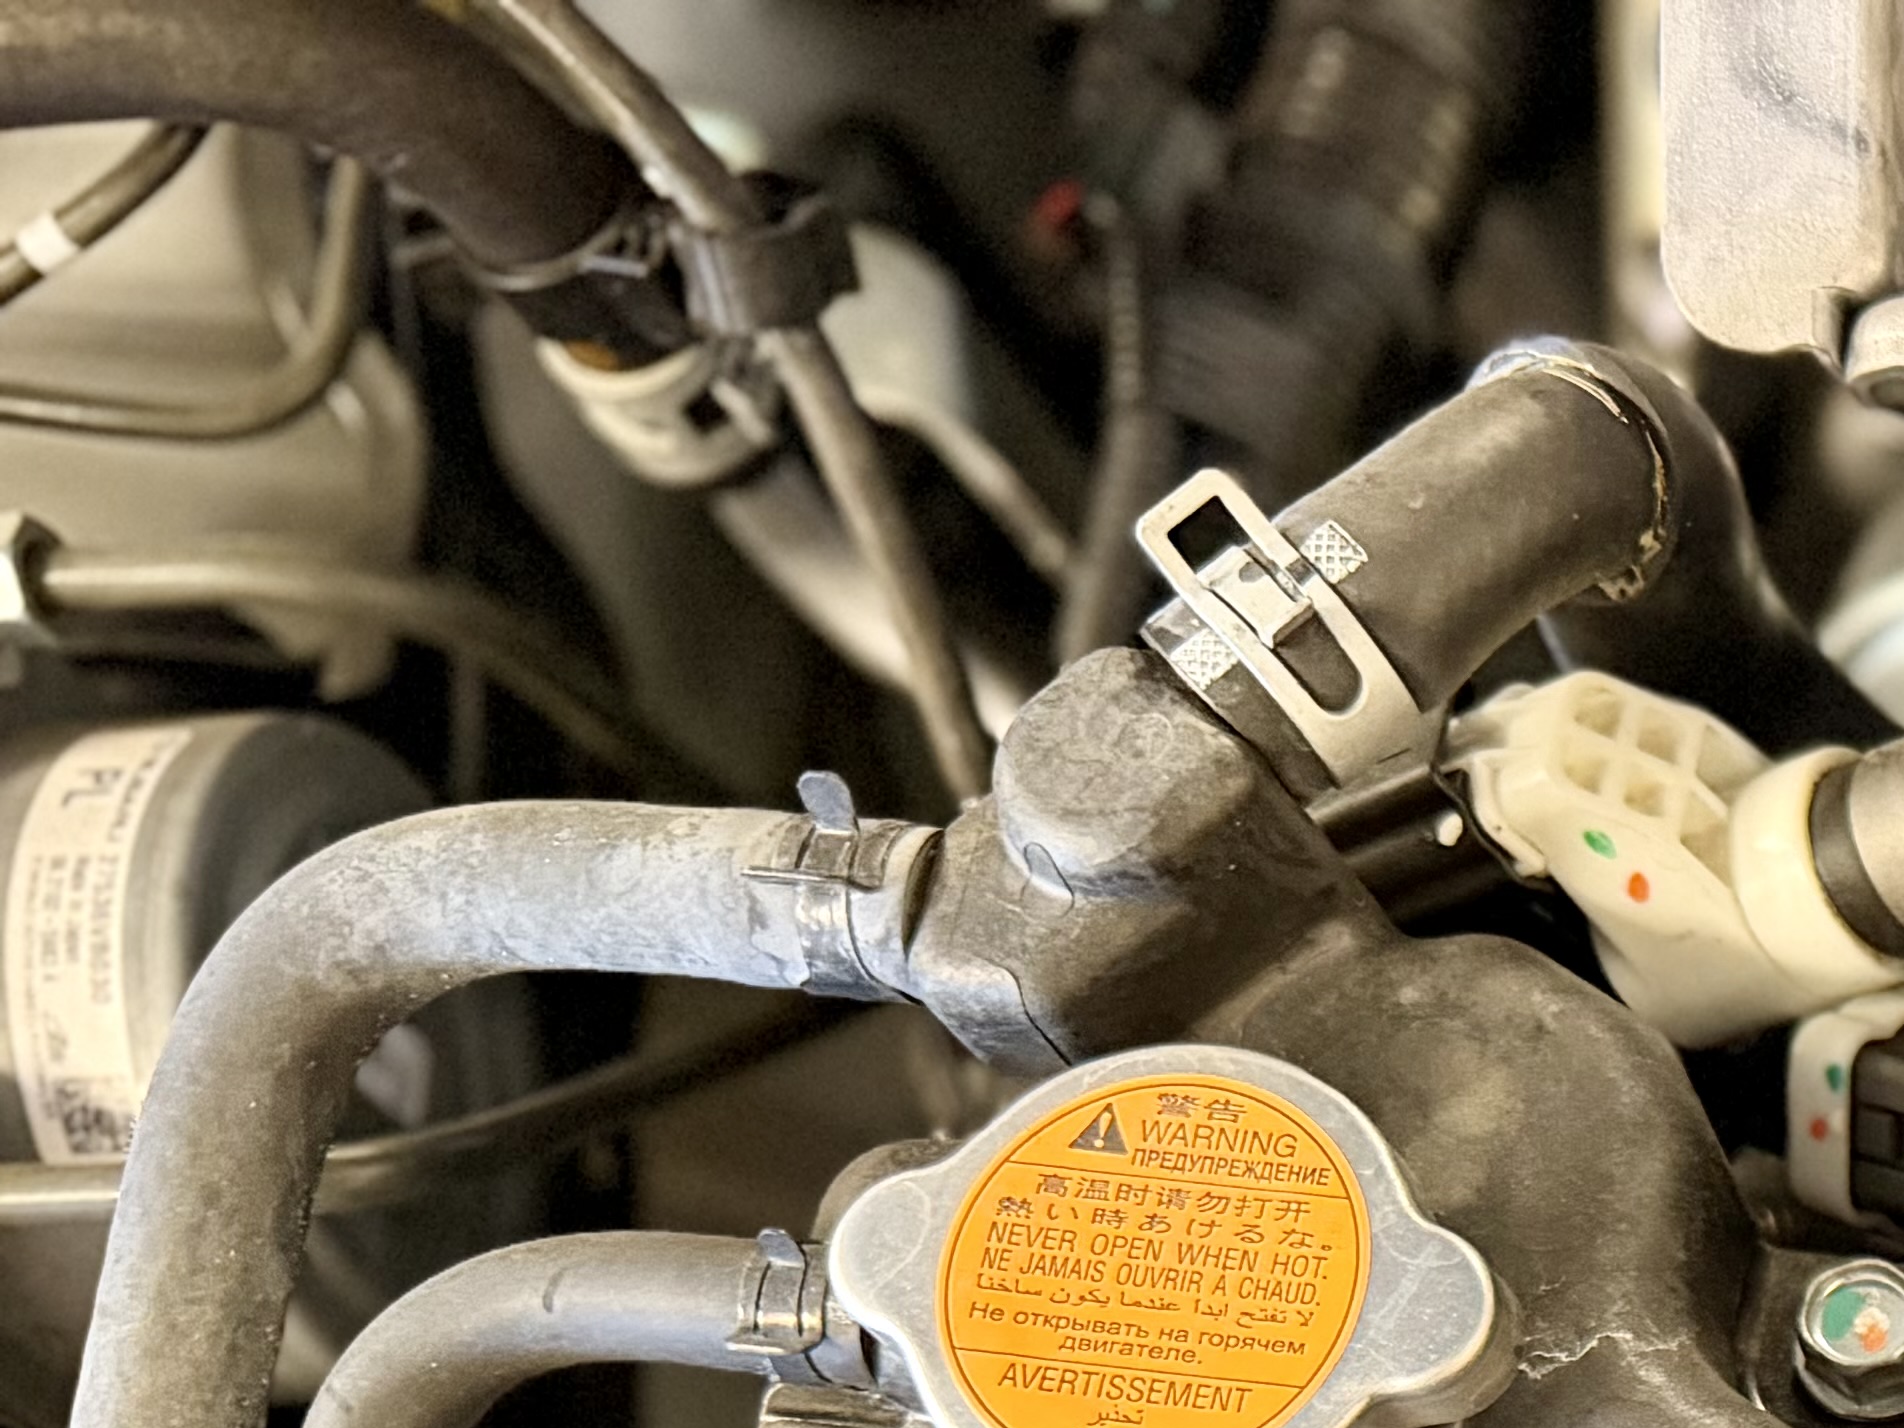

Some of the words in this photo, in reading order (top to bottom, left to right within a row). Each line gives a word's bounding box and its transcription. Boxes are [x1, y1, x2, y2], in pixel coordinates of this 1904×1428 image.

[1157, 1092, 1247, 1124] 警告
[1141, 1119, 1298, 1158] WARNING
[1131, 1147, 1332, 1186] ПРЕДУПРЕЖДЕНИЕ
[995, 1195, 1333, 1252] 熱い時あけるな。
[1035, 1172, 1312, 1224] 高温时请勿打开
[980, 1246, 1014, 1273] NE
[1019, 1252, 1107, 1284] JAMAIS
[1115, 1262, 1204, 1294] OUVRIR
[1237, 1275, 1322, 1307] CHAUD.
[986, 1220, 1078, 1253] NEVER
[1090, 1233, 1164, 1263] OPEN
[1176, 1242, 1259, 1273] WHEN
[1270, 1252, 1329, 1281] HOT.
[1048, 1286, 1111, 1308] يكون
[968, 1301, 1006, 1323] Не
[1012, 1310, 1150, 1340] открывать
[1158, 1326, 1190, 1344] на
[1198, 1329, 1307, 1356] горячем
[1057, 1334, 1203, 1365] двигателе.
[997, 1362, 1254, 1414] AVERTISSEMENT
